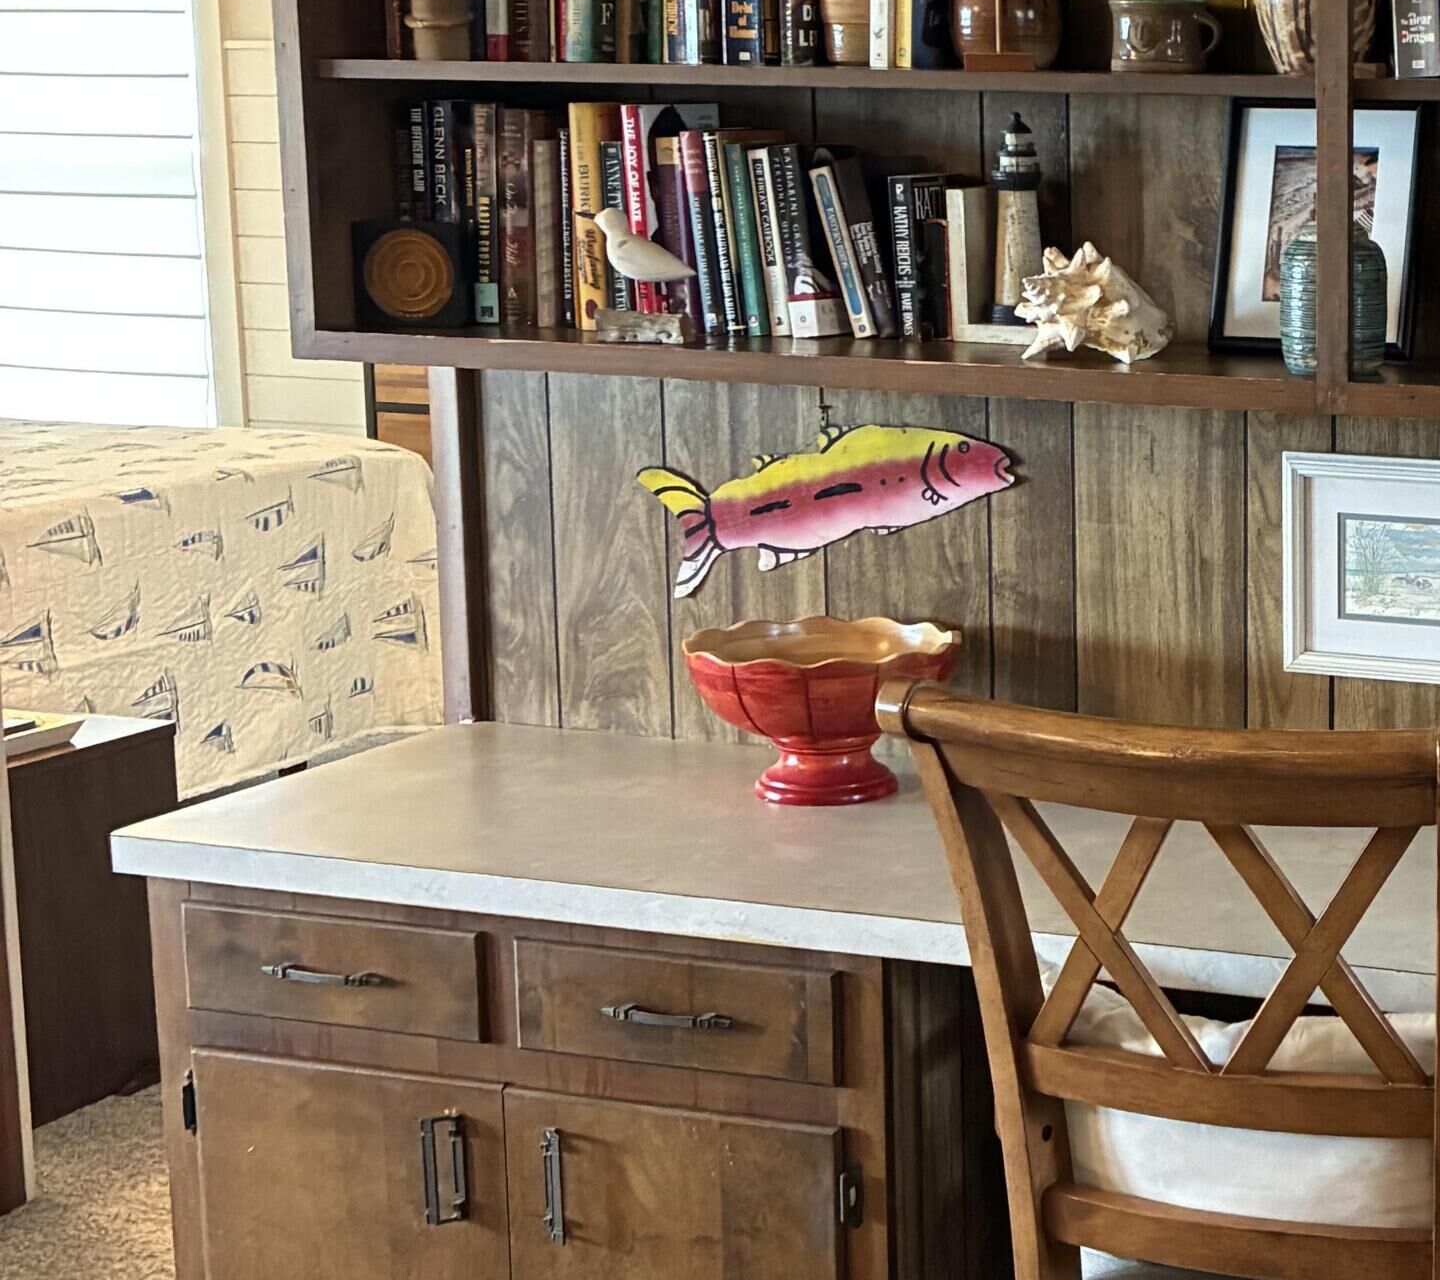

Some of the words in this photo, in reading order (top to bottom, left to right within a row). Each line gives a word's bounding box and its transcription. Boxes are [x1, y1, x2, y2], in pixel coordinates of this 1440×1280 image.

[433, 106, 445, 160] GLENN
[625, 117, 635, 140] THE
[627, 145, 638, 167] JOY
[435, 164, 446, 205] BECK
[605, 158, 621, 189] ANNE
[631, 170, 639, 189] OF
[893, 206, 908, 238] KATHY
[896, 240, 912, 275] REICHS
